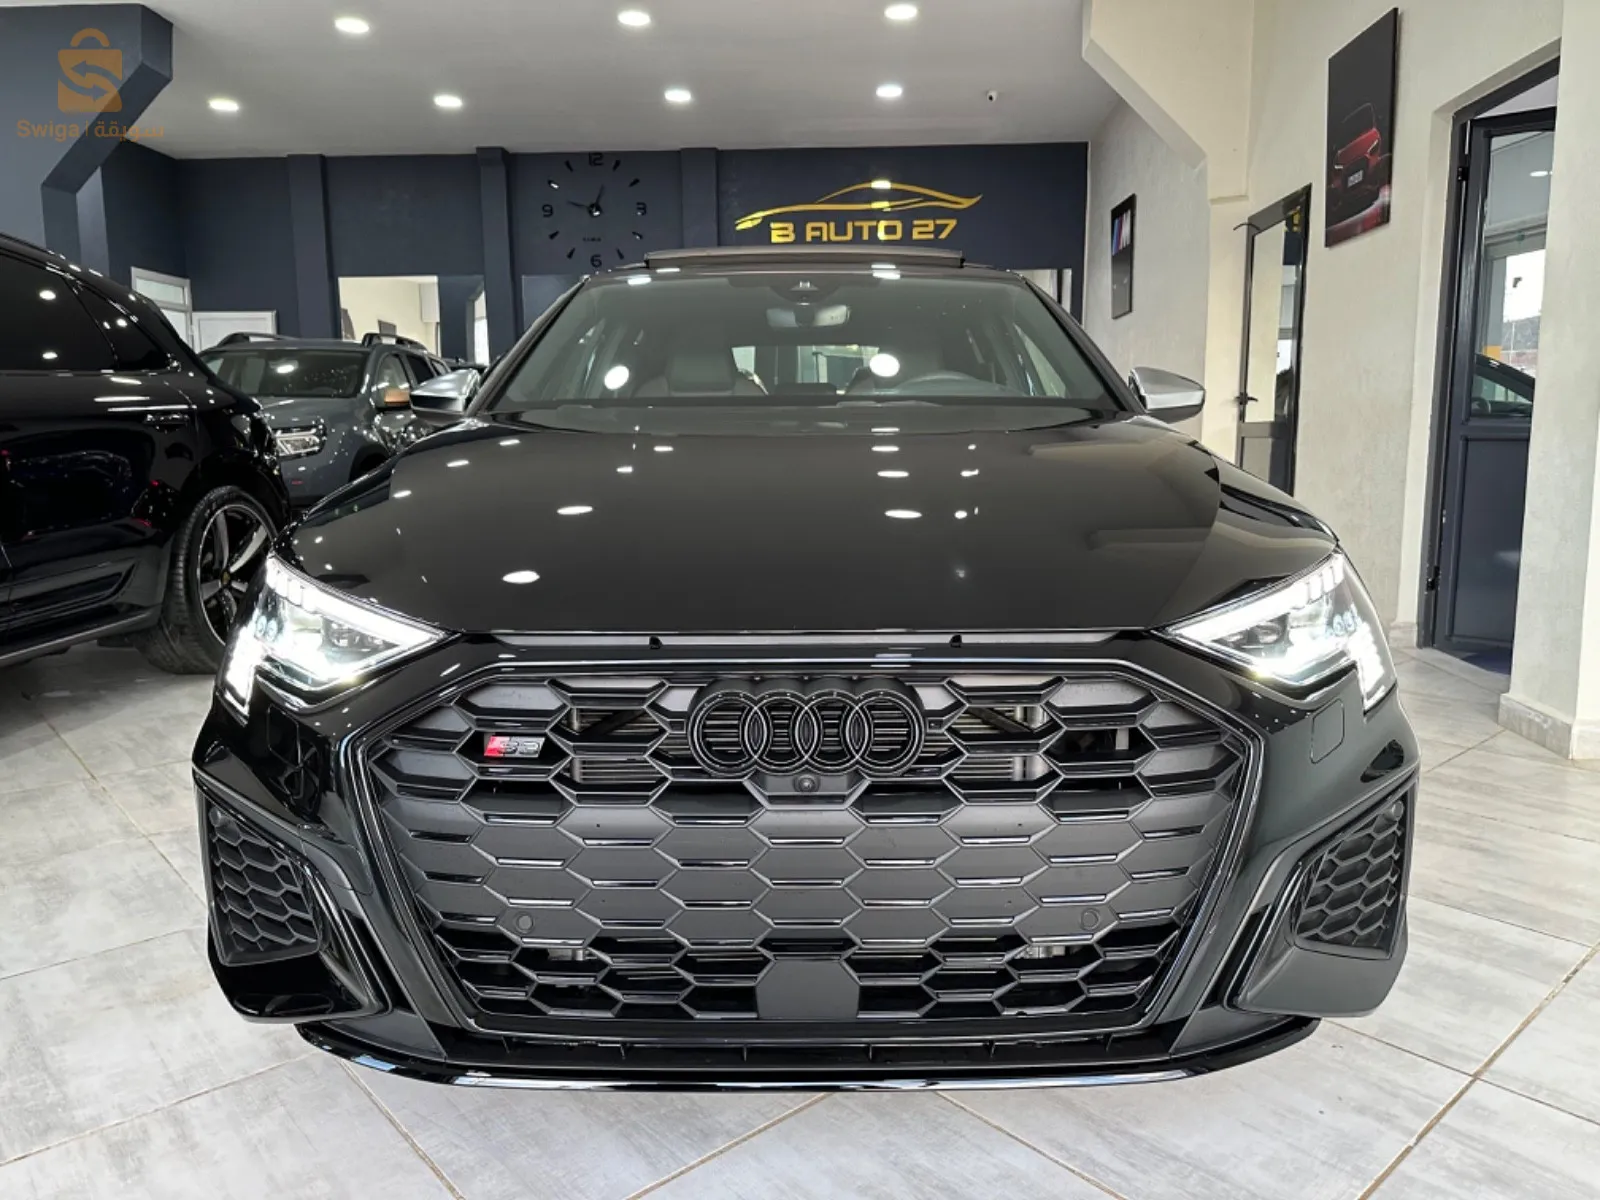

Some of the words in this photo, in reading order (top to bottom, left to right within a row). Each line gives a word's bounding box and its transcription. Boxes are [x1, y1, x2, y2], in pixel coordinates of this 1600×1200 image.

[588, 152, 604, 167] 12
[541, 203, 554, 218] 9
[636, 202, 647, 216] 3
[770, 221, 796, 243] B
[805, 219, 903, 242] AUTO
[911, 218, 958, 241] 27
[590, 253, 603, 268] 6
[497, 739, 541, 756] S3
